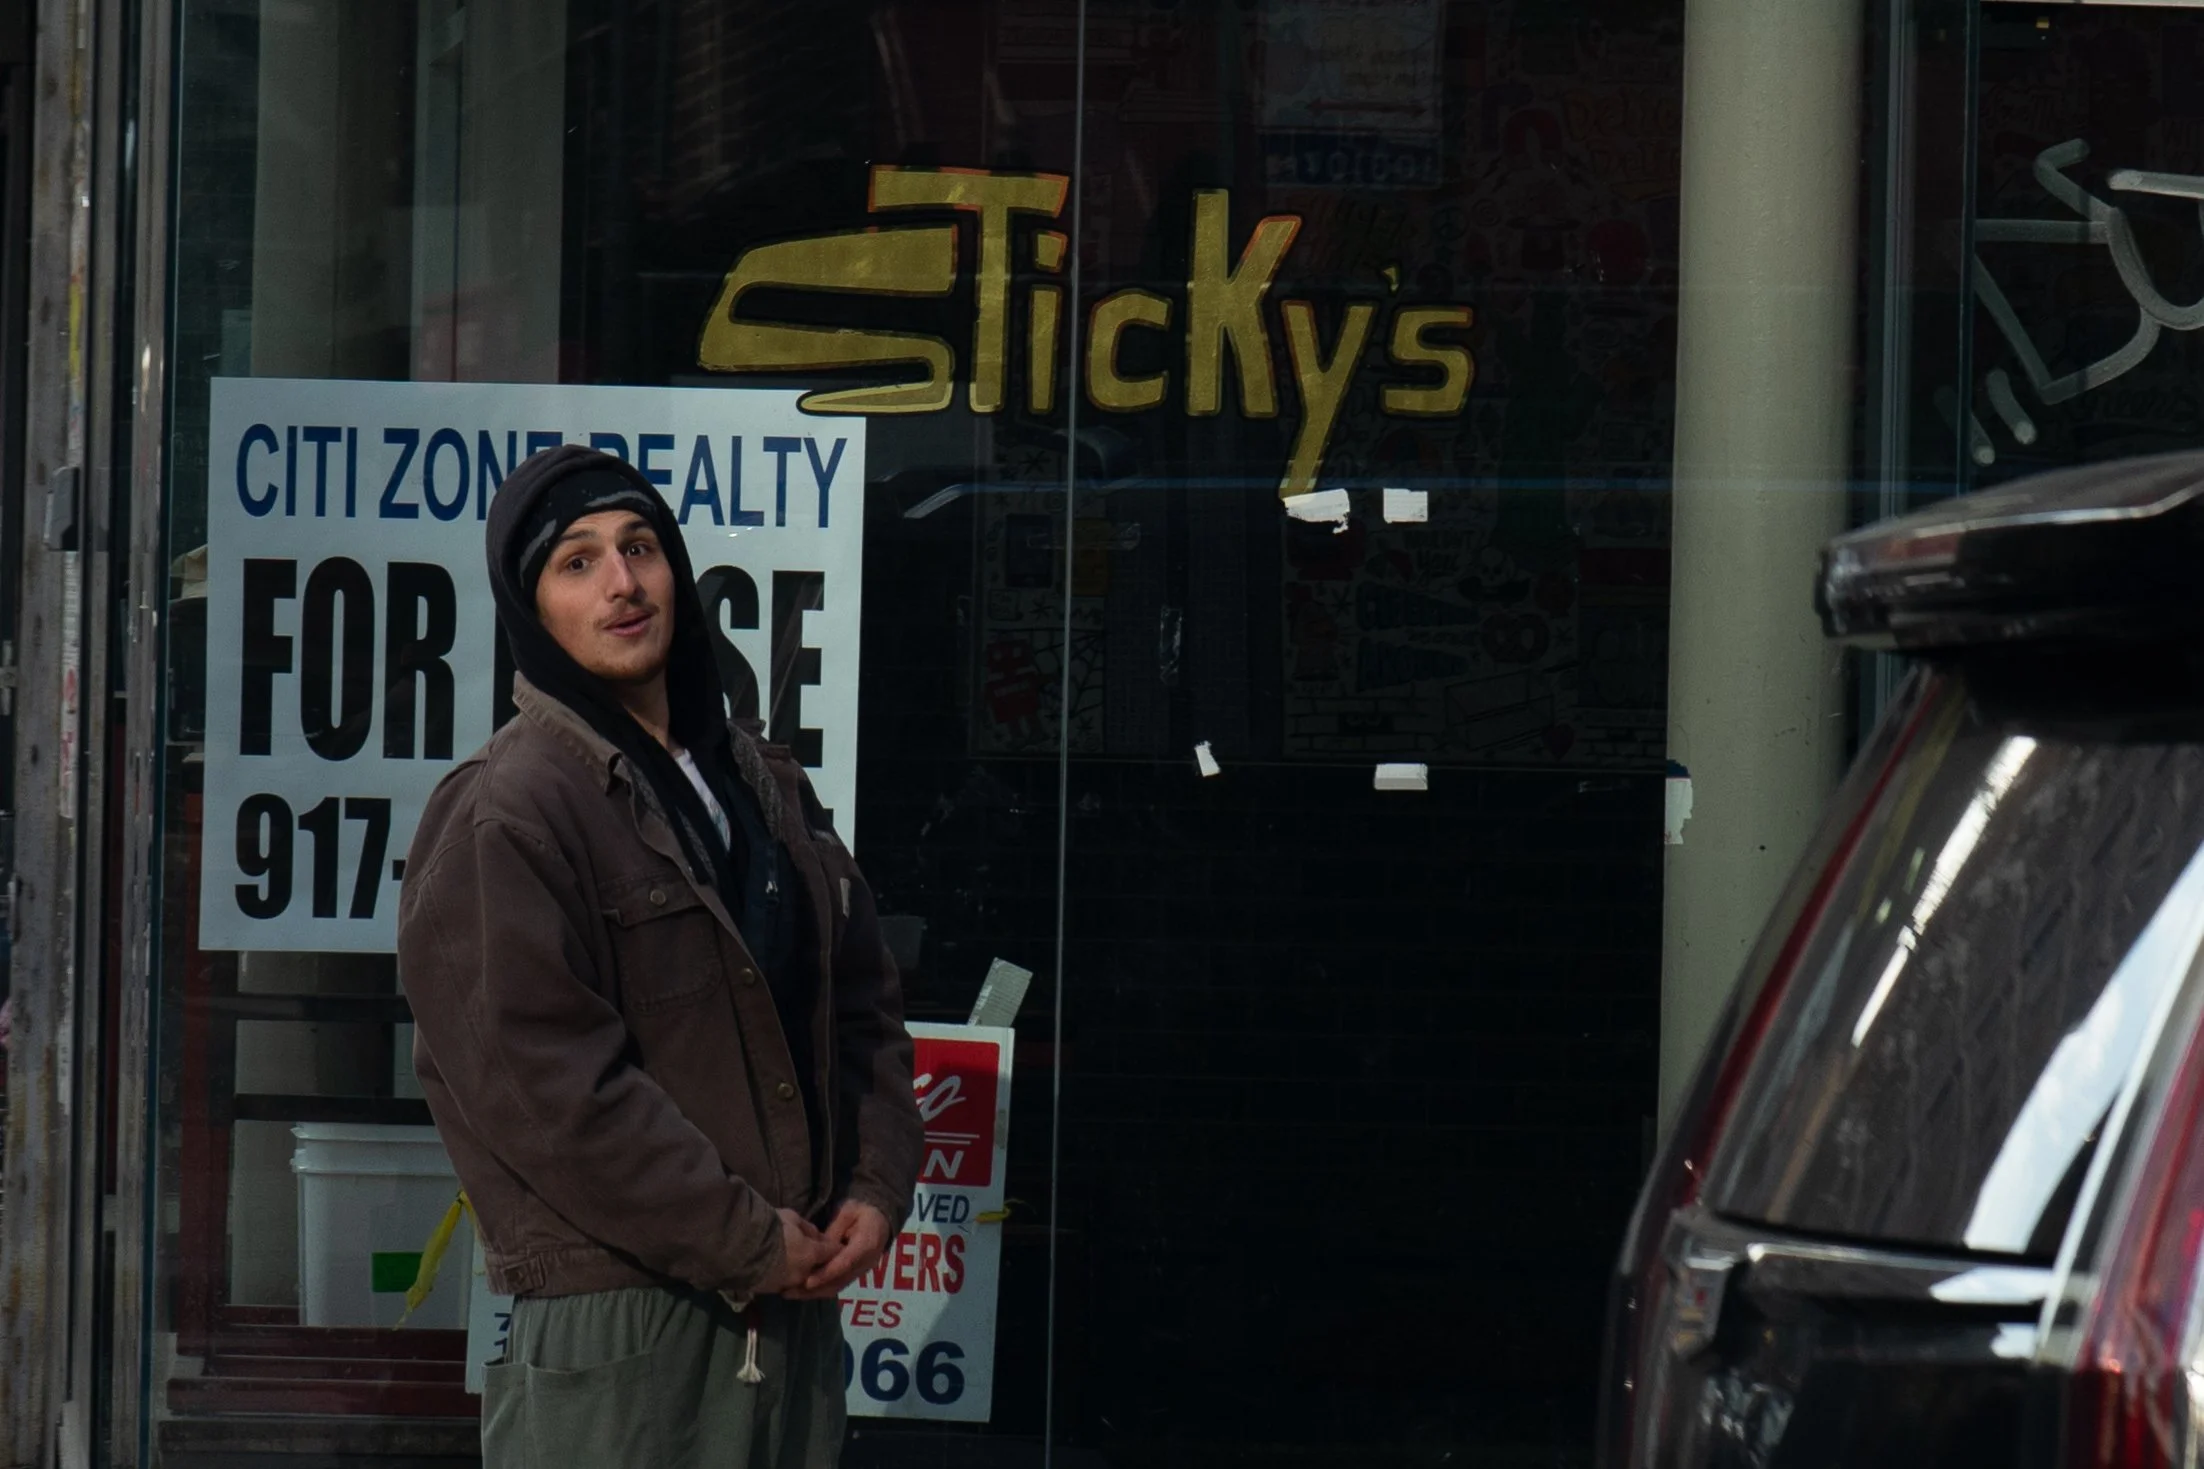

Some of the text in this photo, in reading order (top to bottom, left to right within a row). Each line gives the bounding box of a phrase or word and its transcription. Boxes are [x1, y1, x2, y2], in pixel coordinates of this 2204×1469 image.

[235, 423, 358, 518] CITI
[379, 427, 563, 522] ZON
[239, 556, 457, 761] FOR
[917, 1193, 970, 1223] VED
[844, 1338, 965, 1404] 66
